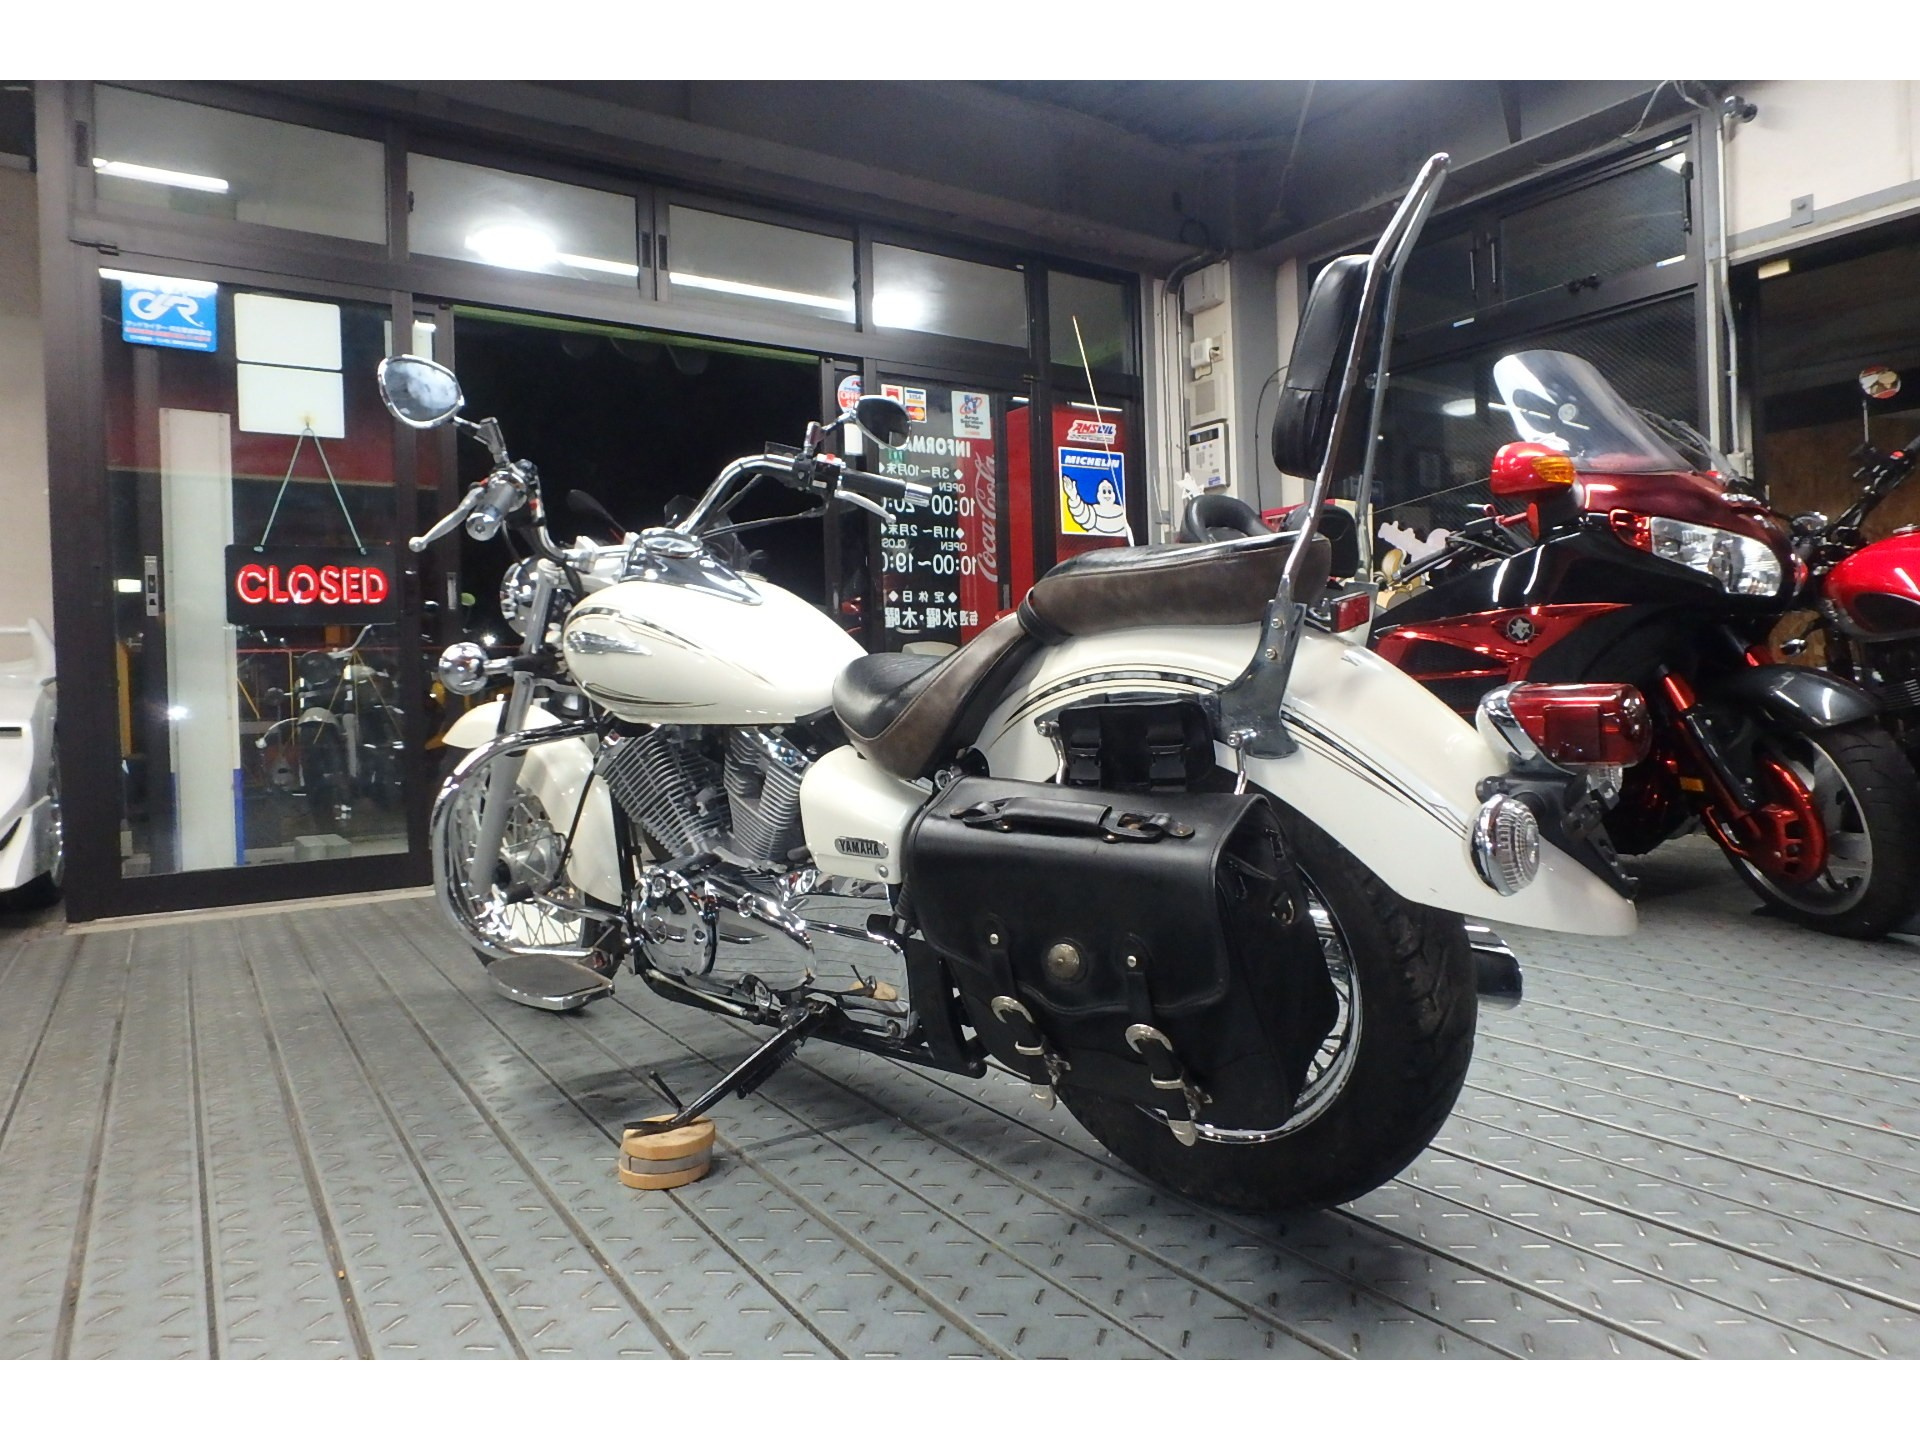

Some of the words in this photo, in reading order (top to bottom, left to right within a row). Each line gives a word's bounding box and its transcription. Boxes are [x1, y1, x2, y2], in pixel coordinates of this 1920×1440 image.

[1072, 422, 1114, 435] AMSOIL
[1064, 455, 1120, 468] MICHELIN
[236, 563, 388, 604] CLOSED
[839, 839, 881, 856] YAMAHA
